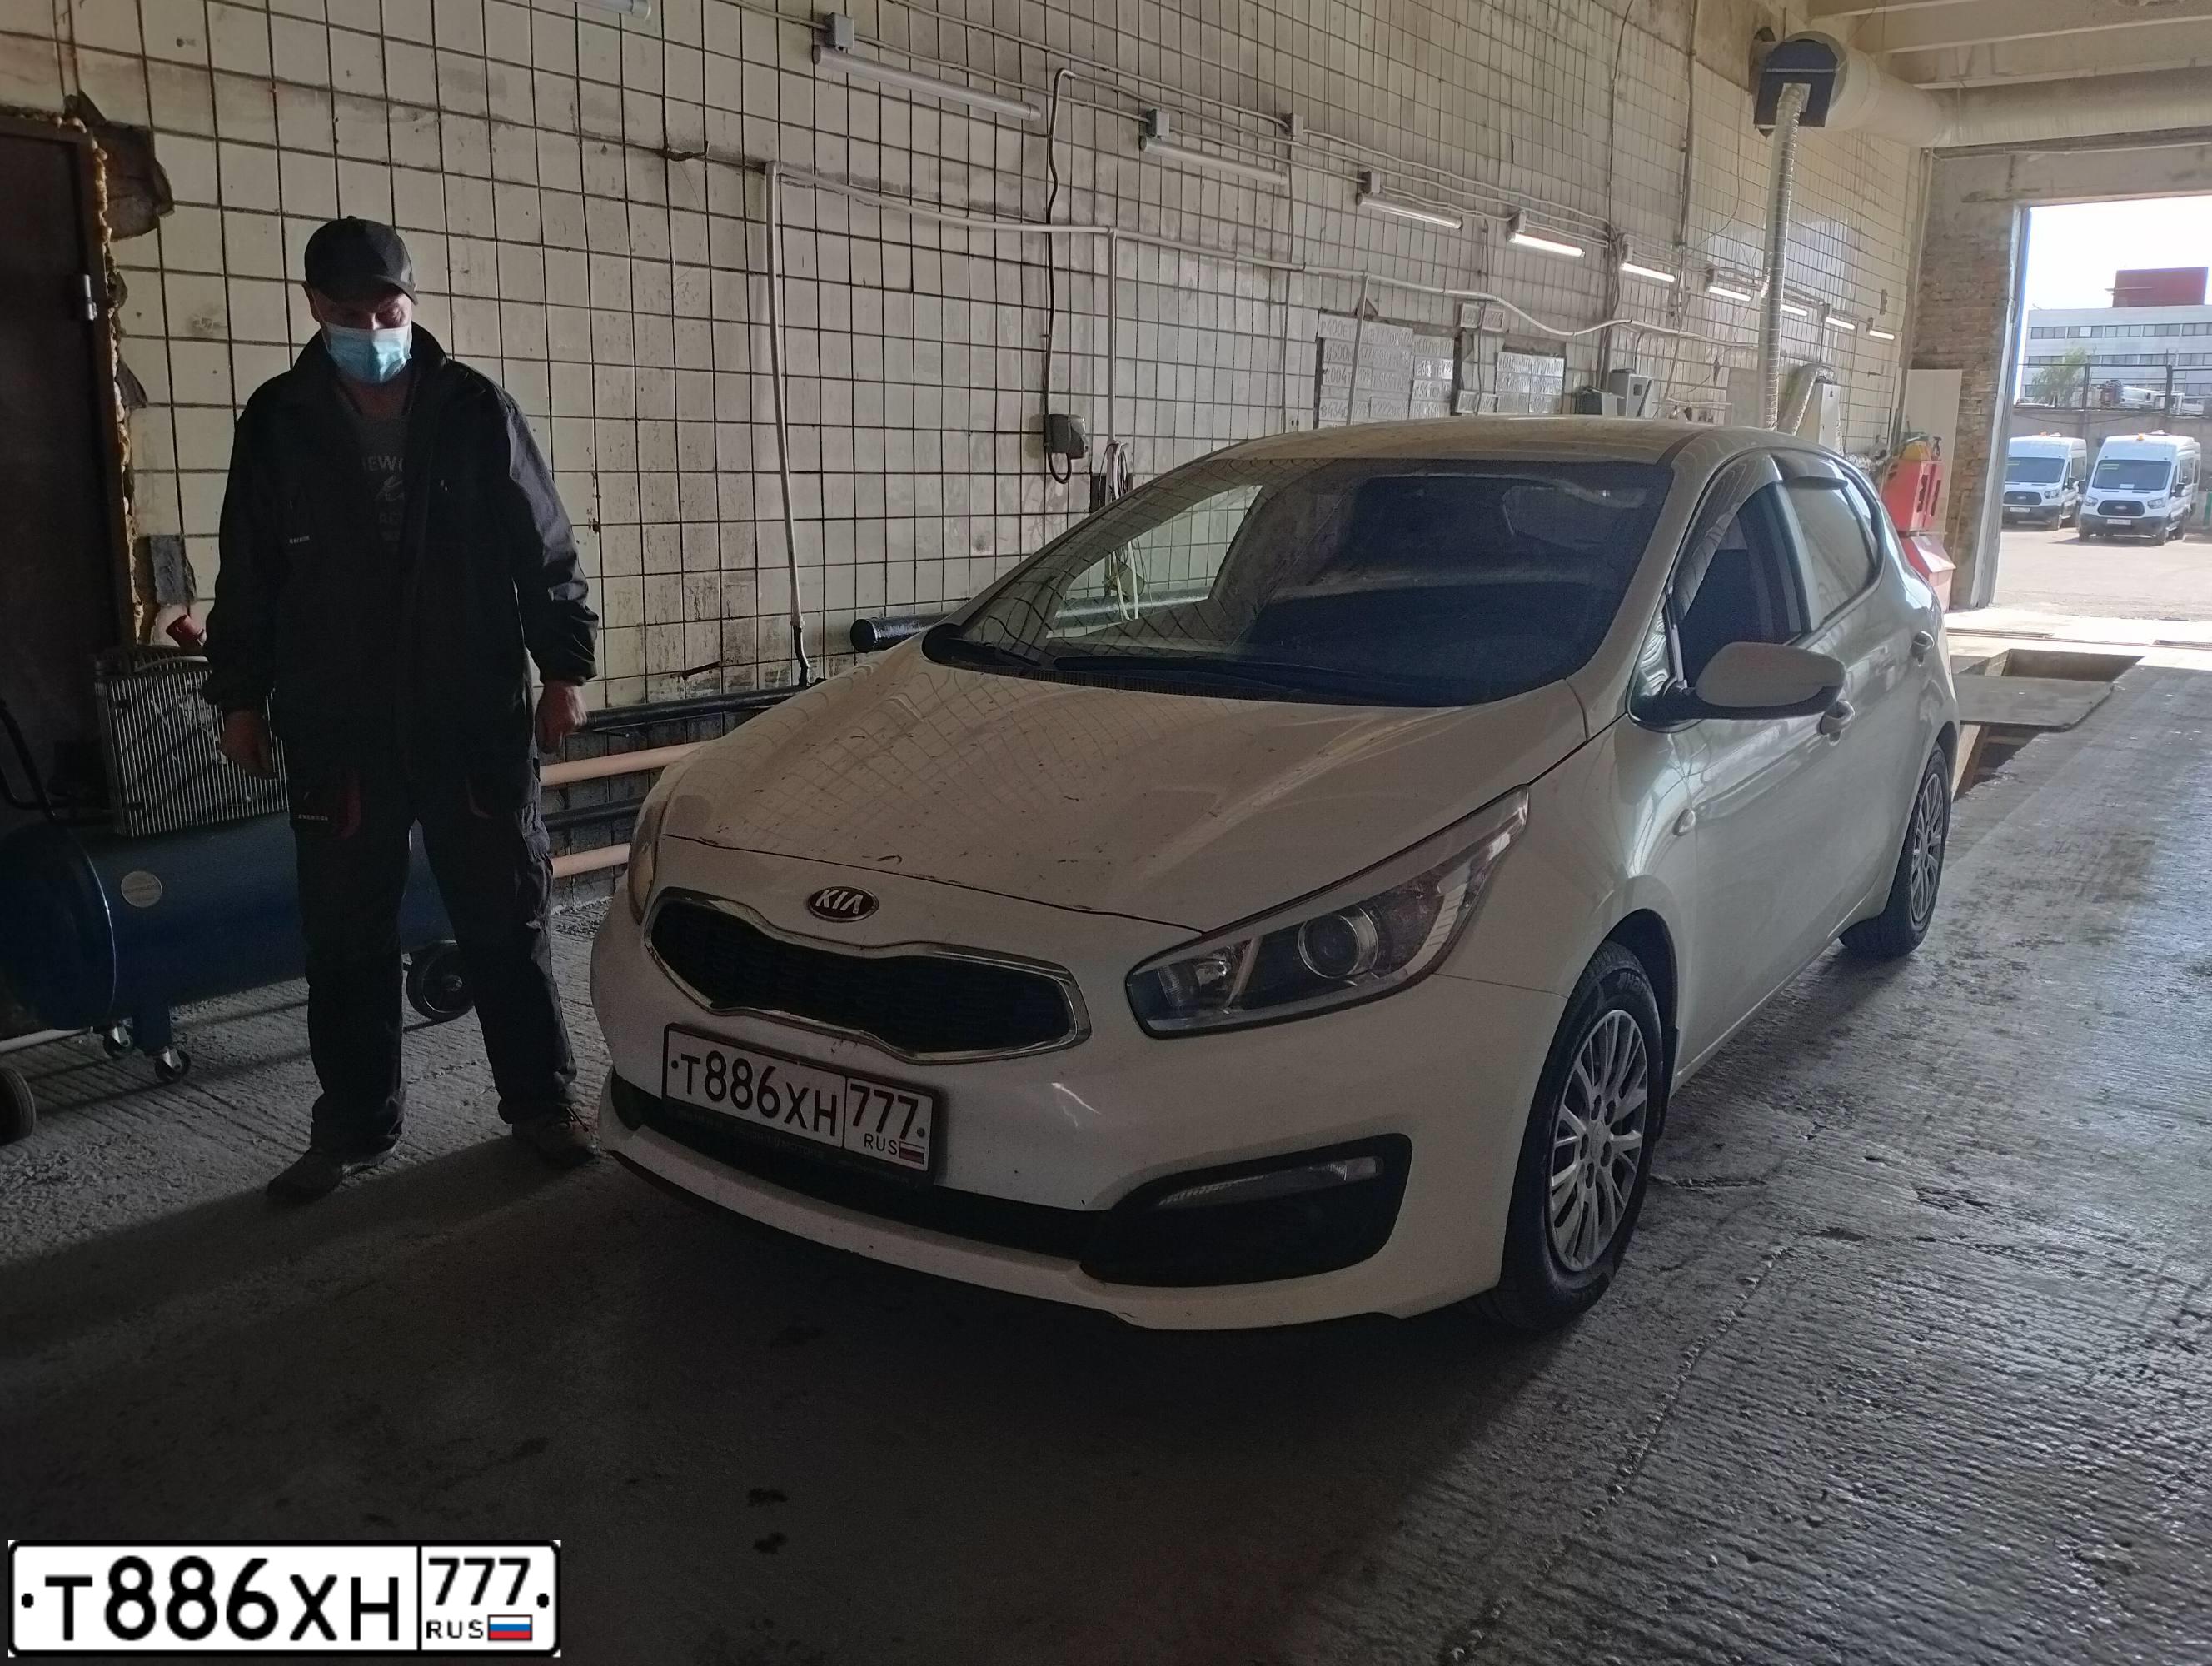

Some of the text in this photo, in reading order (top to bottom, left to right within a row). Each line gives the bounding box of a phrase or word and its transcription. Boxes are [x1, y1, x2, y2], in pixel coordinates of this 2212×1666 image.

[815, 889, 864, 915] KIA
[680, 1050, 919, 1140] Т886ХН 777
[864, 1133, 898, 1155] RUS
